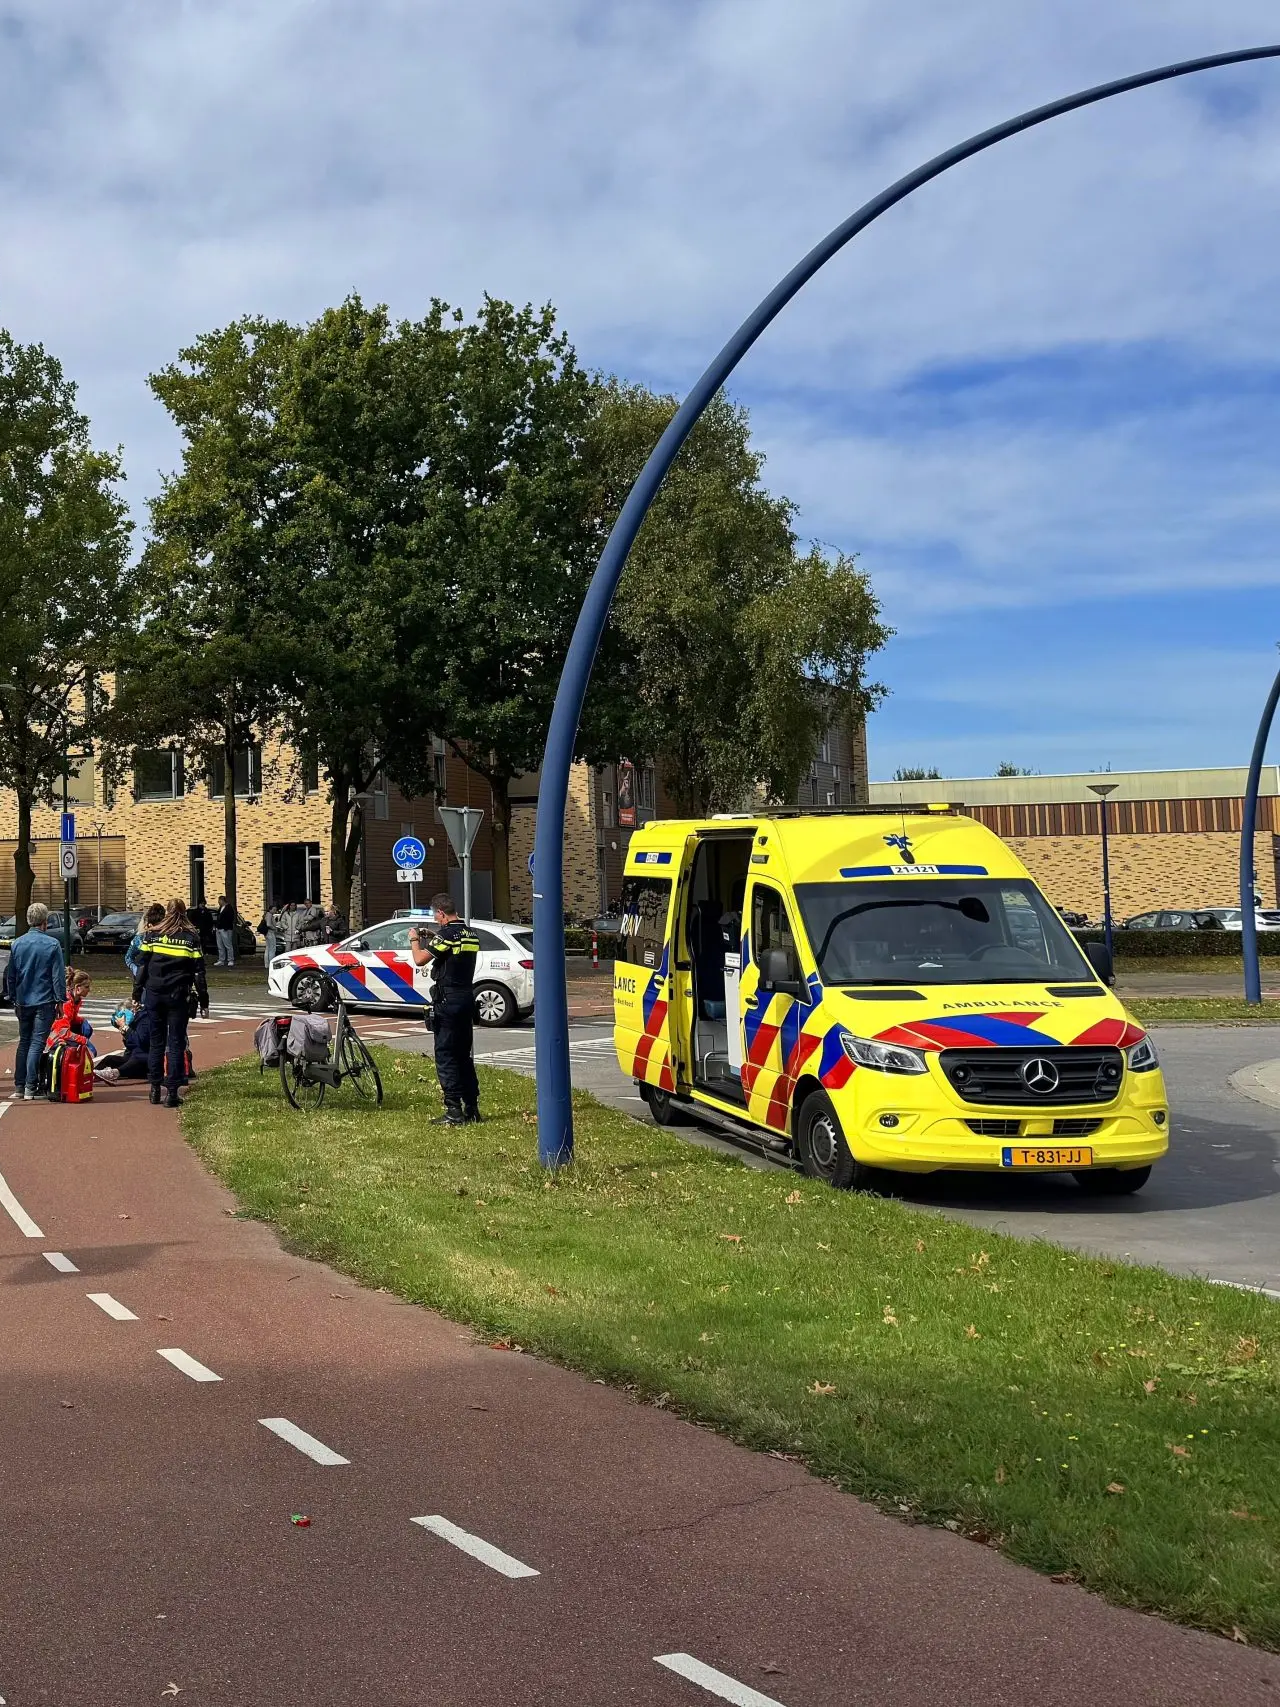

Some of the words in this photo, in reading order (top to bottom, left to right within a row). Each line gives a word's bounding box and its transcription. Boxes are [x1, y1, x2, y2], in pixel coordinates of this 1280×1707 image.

[894, 866, 936, 874] 21-121
[614, 975, 636, 993] LANCE
[942, 1000, 1065, 1010] AMBULANCE
[1020, 1150, 1082, 1164] T-831-JJ
